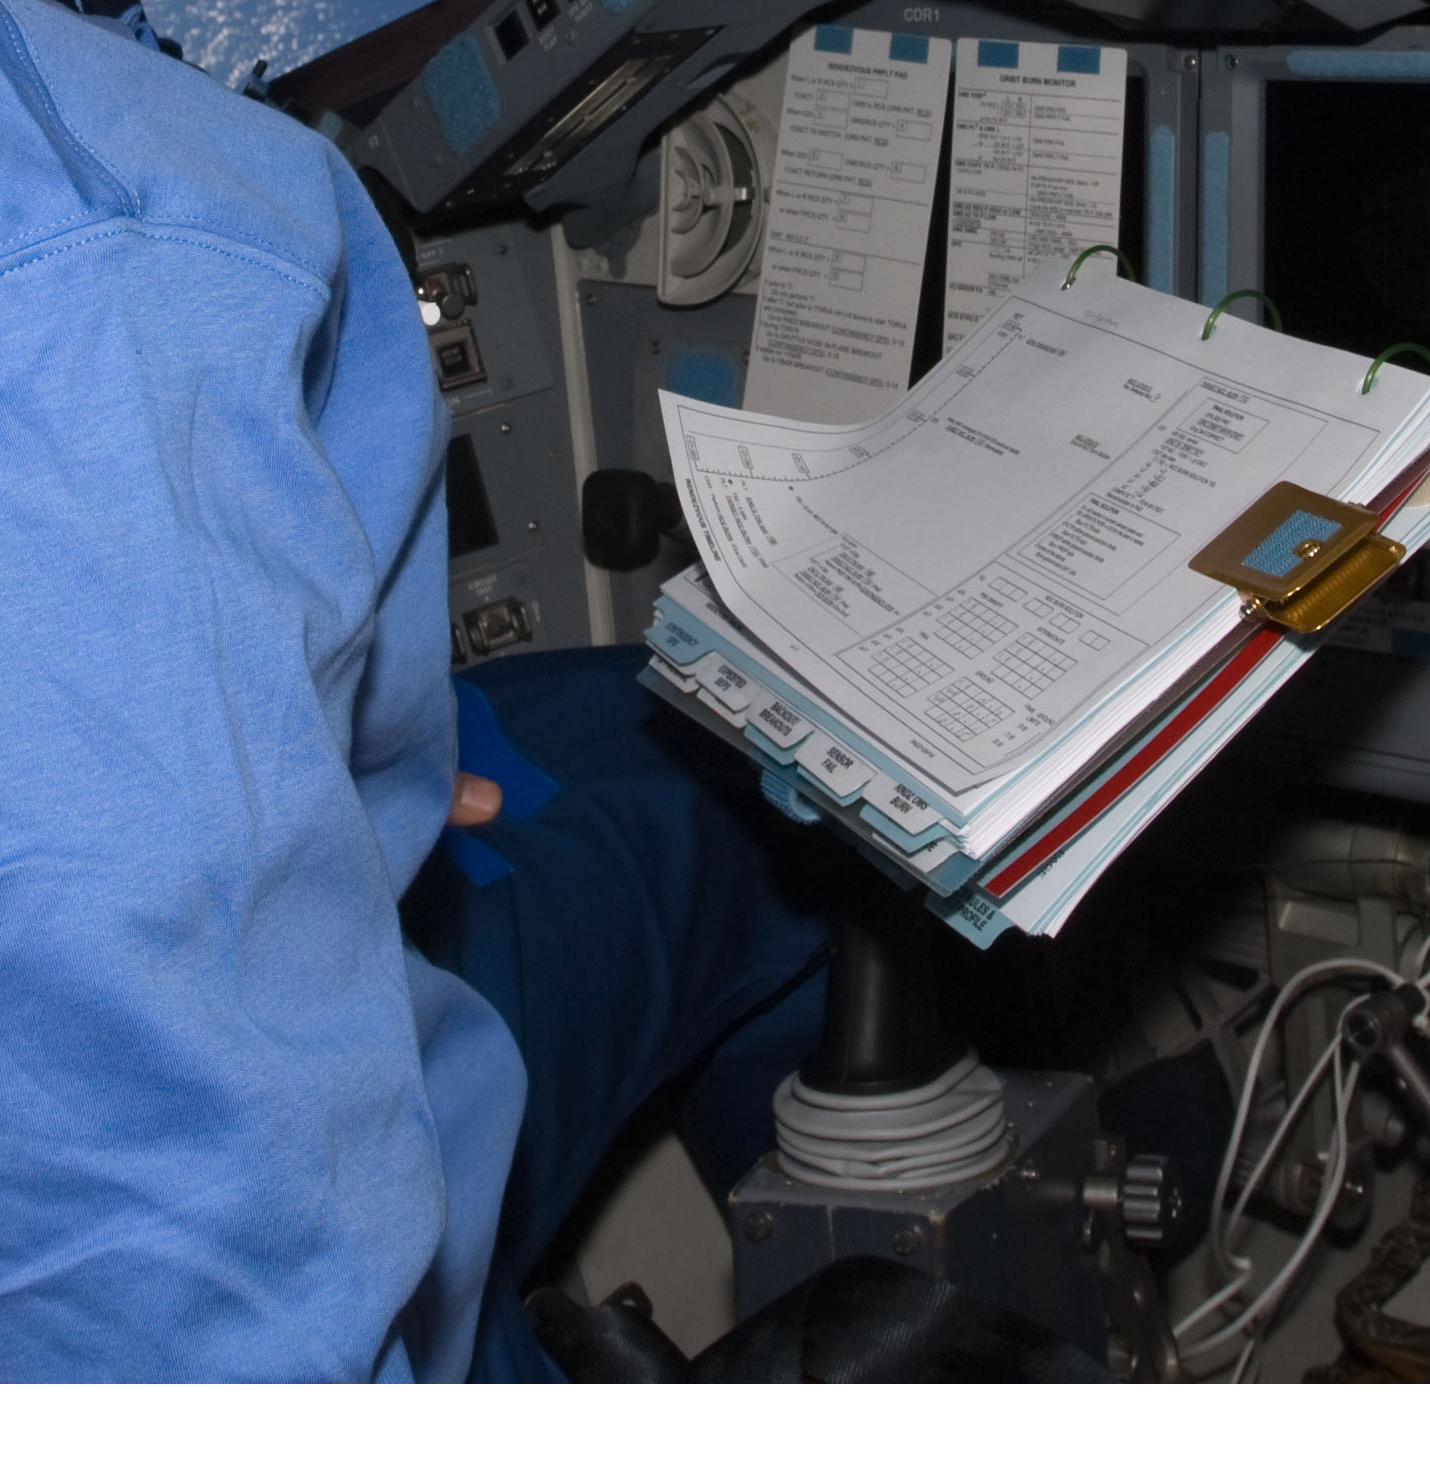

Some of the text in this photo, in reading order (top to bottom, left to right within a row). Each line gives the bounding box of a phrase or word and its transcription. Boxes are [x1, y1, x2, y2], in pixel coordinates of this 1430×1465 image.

[904, 8, 940, 23] CDR1
[821, 757, 838, 774] FAIL
[826, 746, 854, 769] SENSOR
